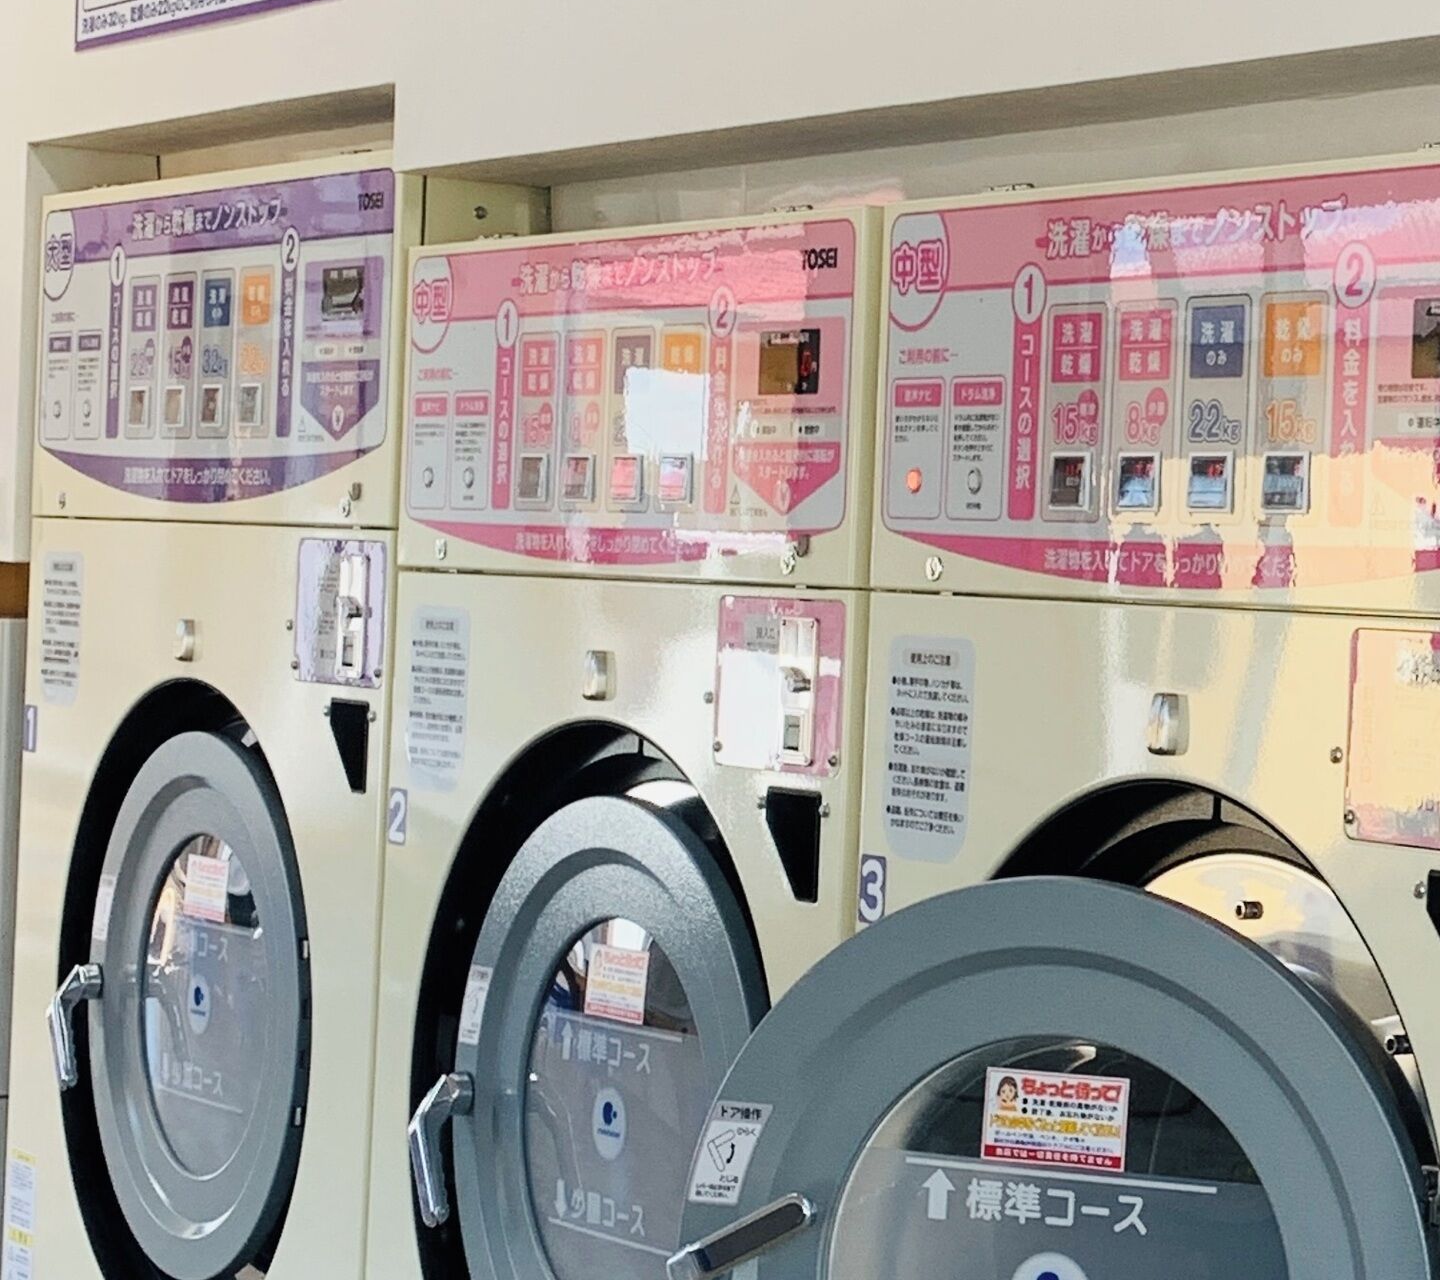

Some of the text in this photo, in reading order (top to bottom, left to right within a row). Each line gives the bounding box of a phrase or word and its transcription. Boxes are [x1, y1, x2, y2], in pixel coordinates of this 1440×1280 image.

[892, 238, 945, 294] 中型
[1015, 334, 1034, 490] コースの選択
[1189, 398, 1241, 445] 22kg
[860, 858, 883, 921] 3
[965, 1176, 1148, 1237] 標準コース
